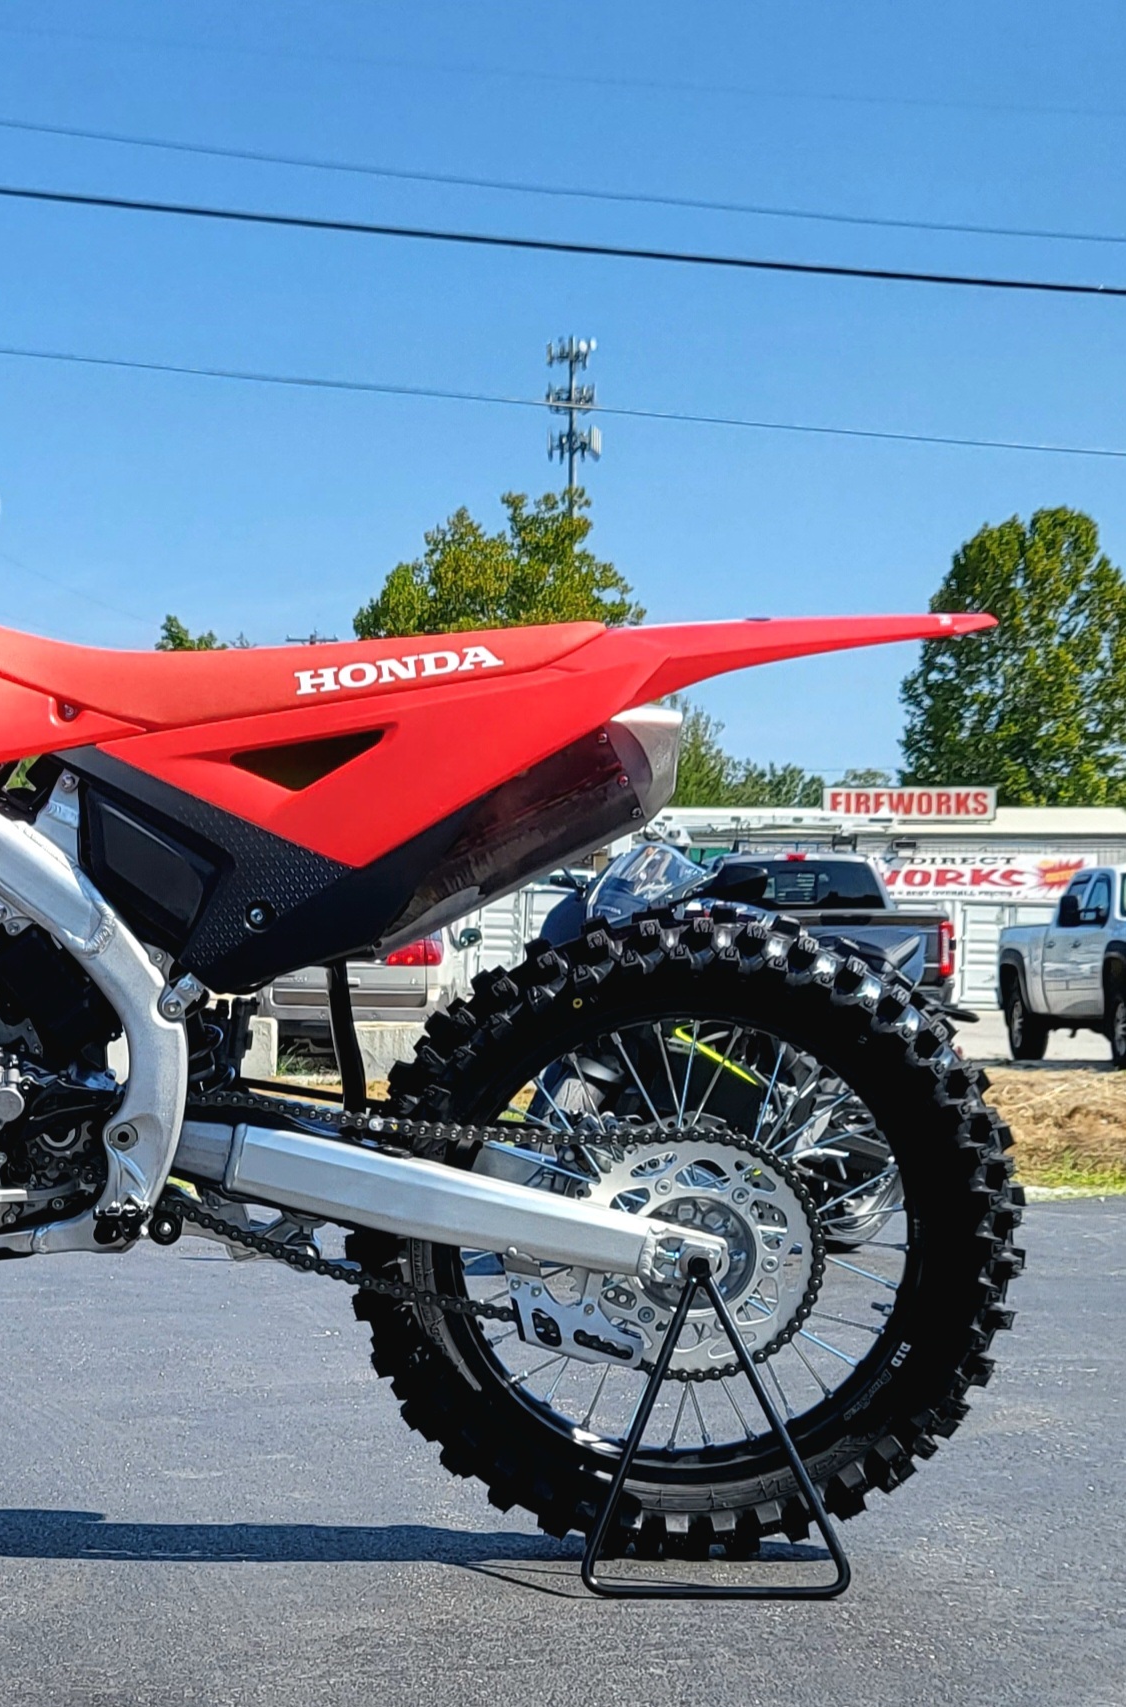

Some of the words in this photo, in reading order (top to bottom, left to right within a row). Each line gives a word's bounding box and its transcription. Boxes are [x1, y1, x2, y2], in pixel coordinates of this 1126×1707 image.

[294, 645, 504, 695] HONDA
[829, 792, 989, 816] FIREWORKS
[909, 857, 1016, 866] DIRECT
